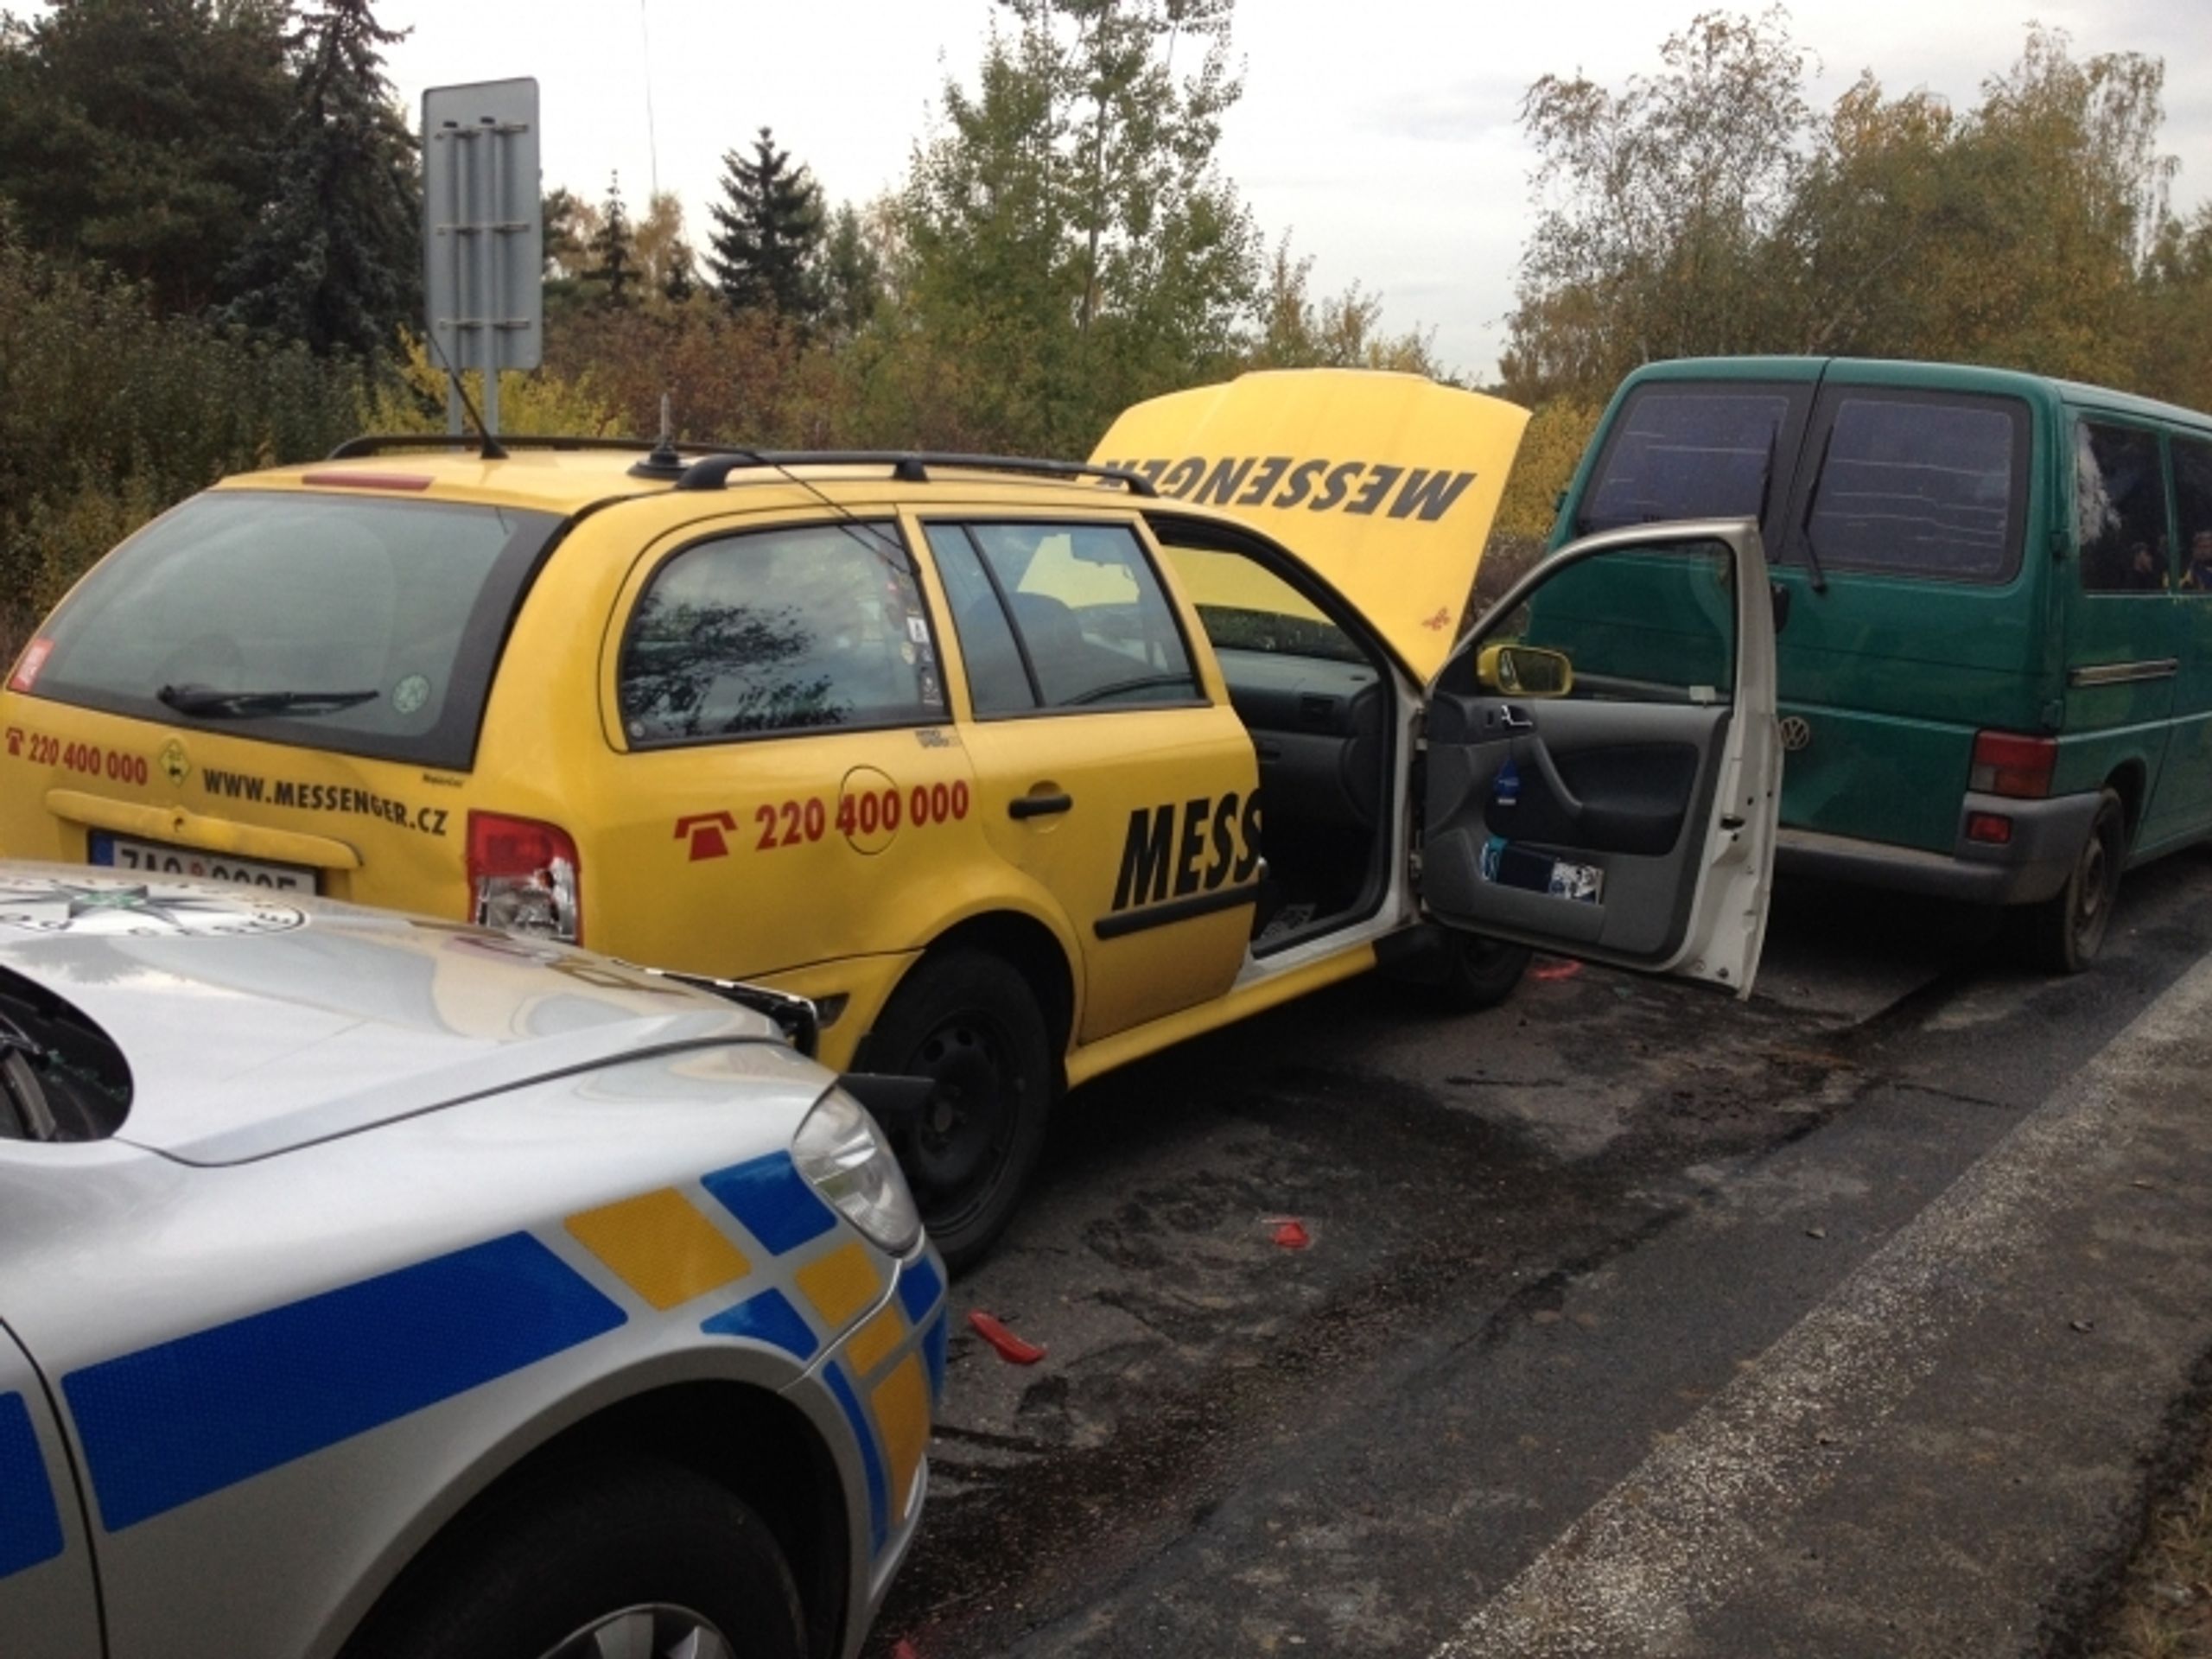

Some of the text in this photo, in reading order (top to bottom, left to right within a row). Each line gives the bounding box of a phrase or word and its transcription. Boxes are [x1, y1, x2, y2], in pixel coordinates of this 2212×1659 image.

[29, 734, 149, 786] 220 400 000
[202, 766, 448, 836] WWW.MESSENGER.CZ
[754, 779, 969, 851] 220 400 000
[1110, 787, 1262, 912] MESS
